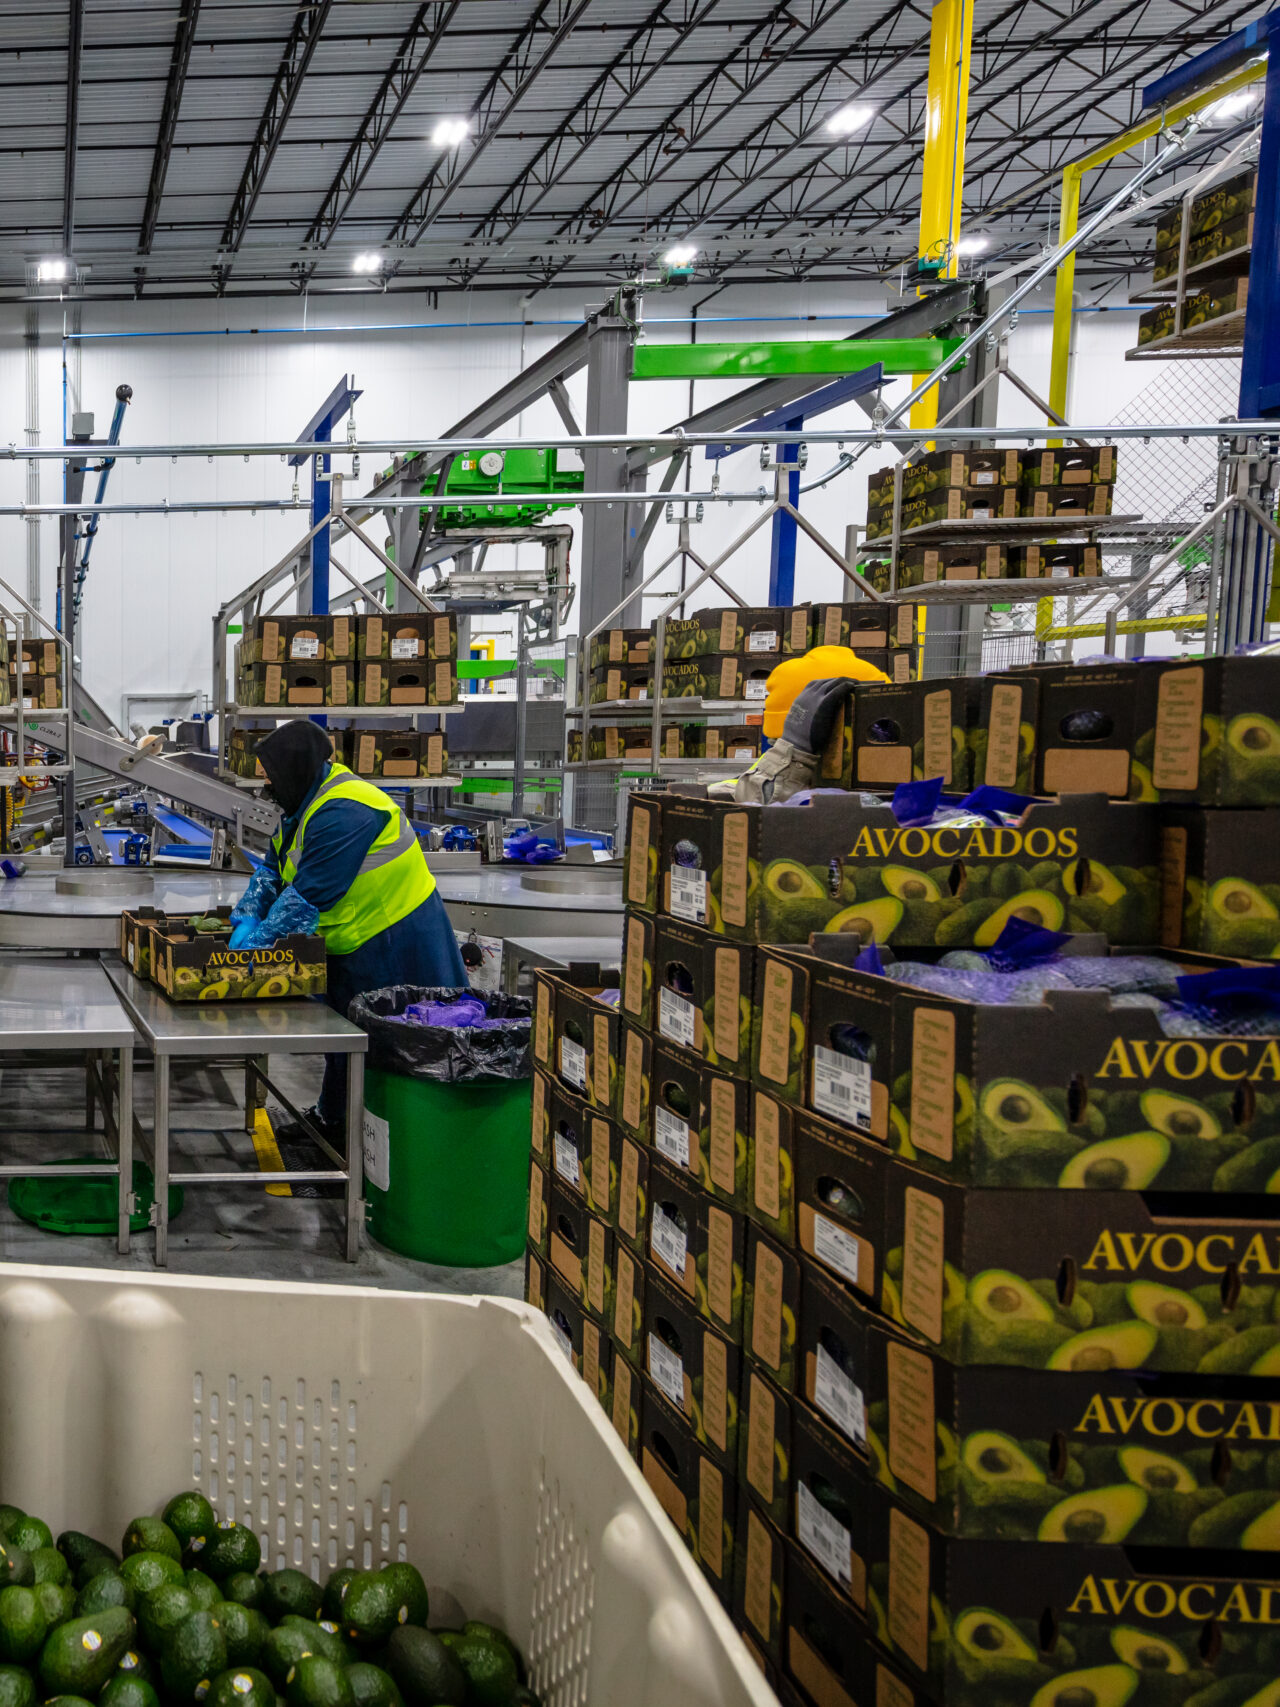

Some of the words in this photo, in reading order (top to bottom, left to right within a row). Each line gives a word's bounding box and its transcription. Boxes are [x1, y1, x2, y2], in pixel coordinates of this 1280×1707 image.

[848, 825, 1079, 858] AVOCADOS
[208, 949, 294, 966] AVOCADOS
[1082, 1228, 1280, 1274] AVOCA
